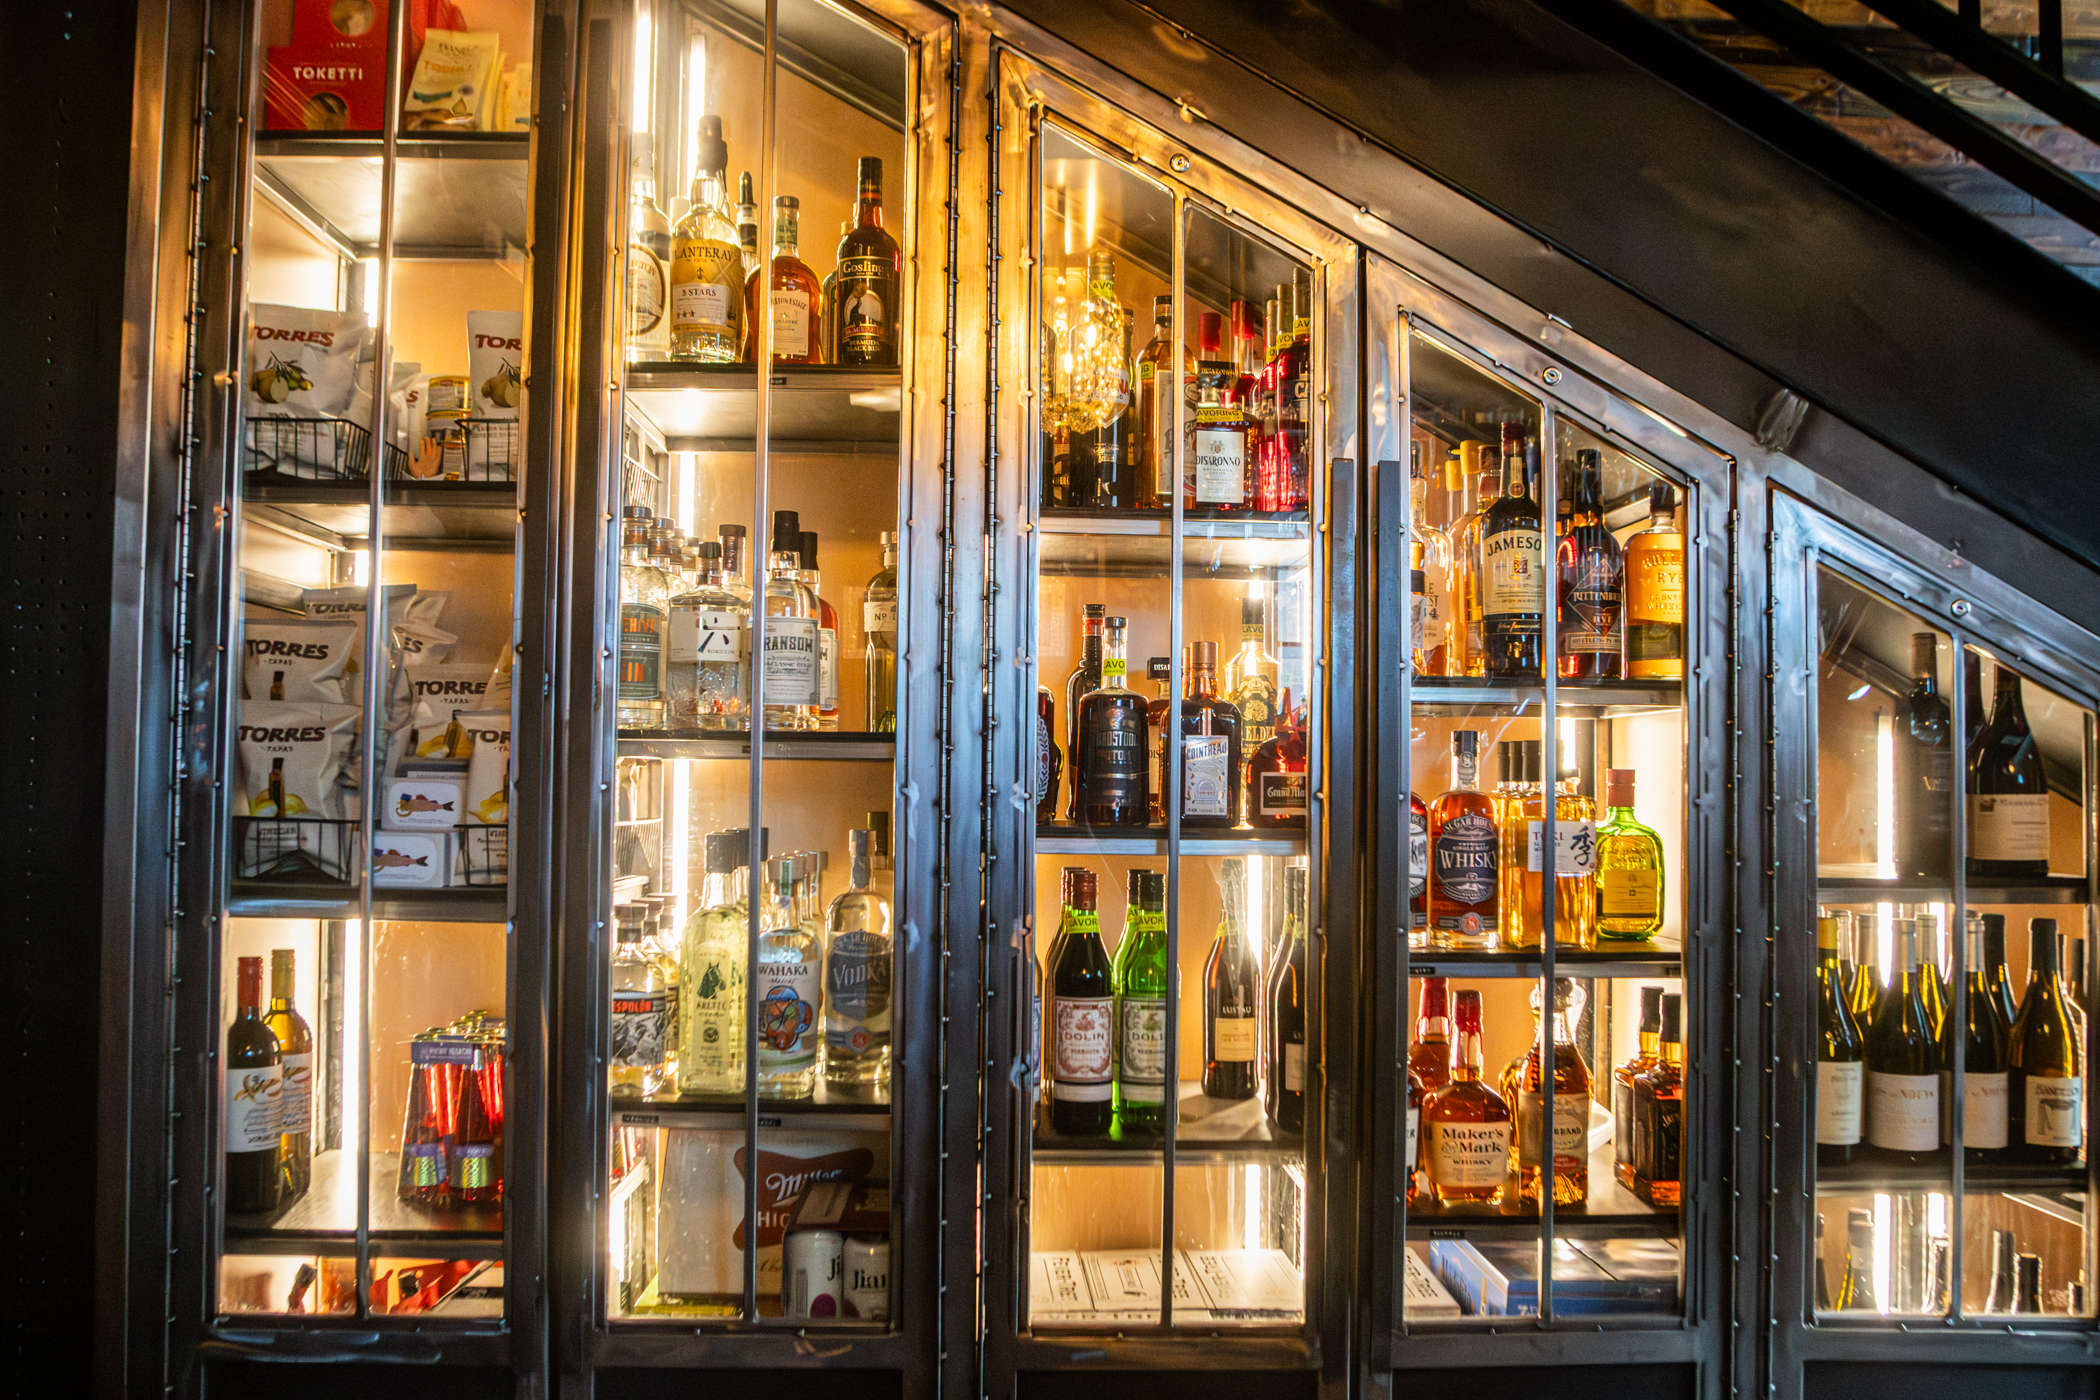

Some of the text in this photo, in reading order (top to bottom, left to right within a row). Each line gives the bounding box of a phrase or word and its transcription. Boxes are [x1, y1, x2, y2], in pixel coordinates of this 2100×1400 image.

[292, 66, 363, 81] TOKETTI
[688, 288, 717, 297] STARS
[1195, 454, 1241, 467] DISARONNO
[245, 639, 329, 660] TORRES
[764, 635, 814, 653] RANSOM
[239, 725, 326, 742] TORRES
[1186, 744, 1228, 761] COINTREAU
[758, 965, 809, 976] WAHAKA
[1222, 1006, 1252, 1014] LUSTAU
[1064, 1032, 1104, 1041] DOLIN
[1442, 1127, 1505, 1139] Maker's
[1459, 1141, 1503, 1153] Mark
